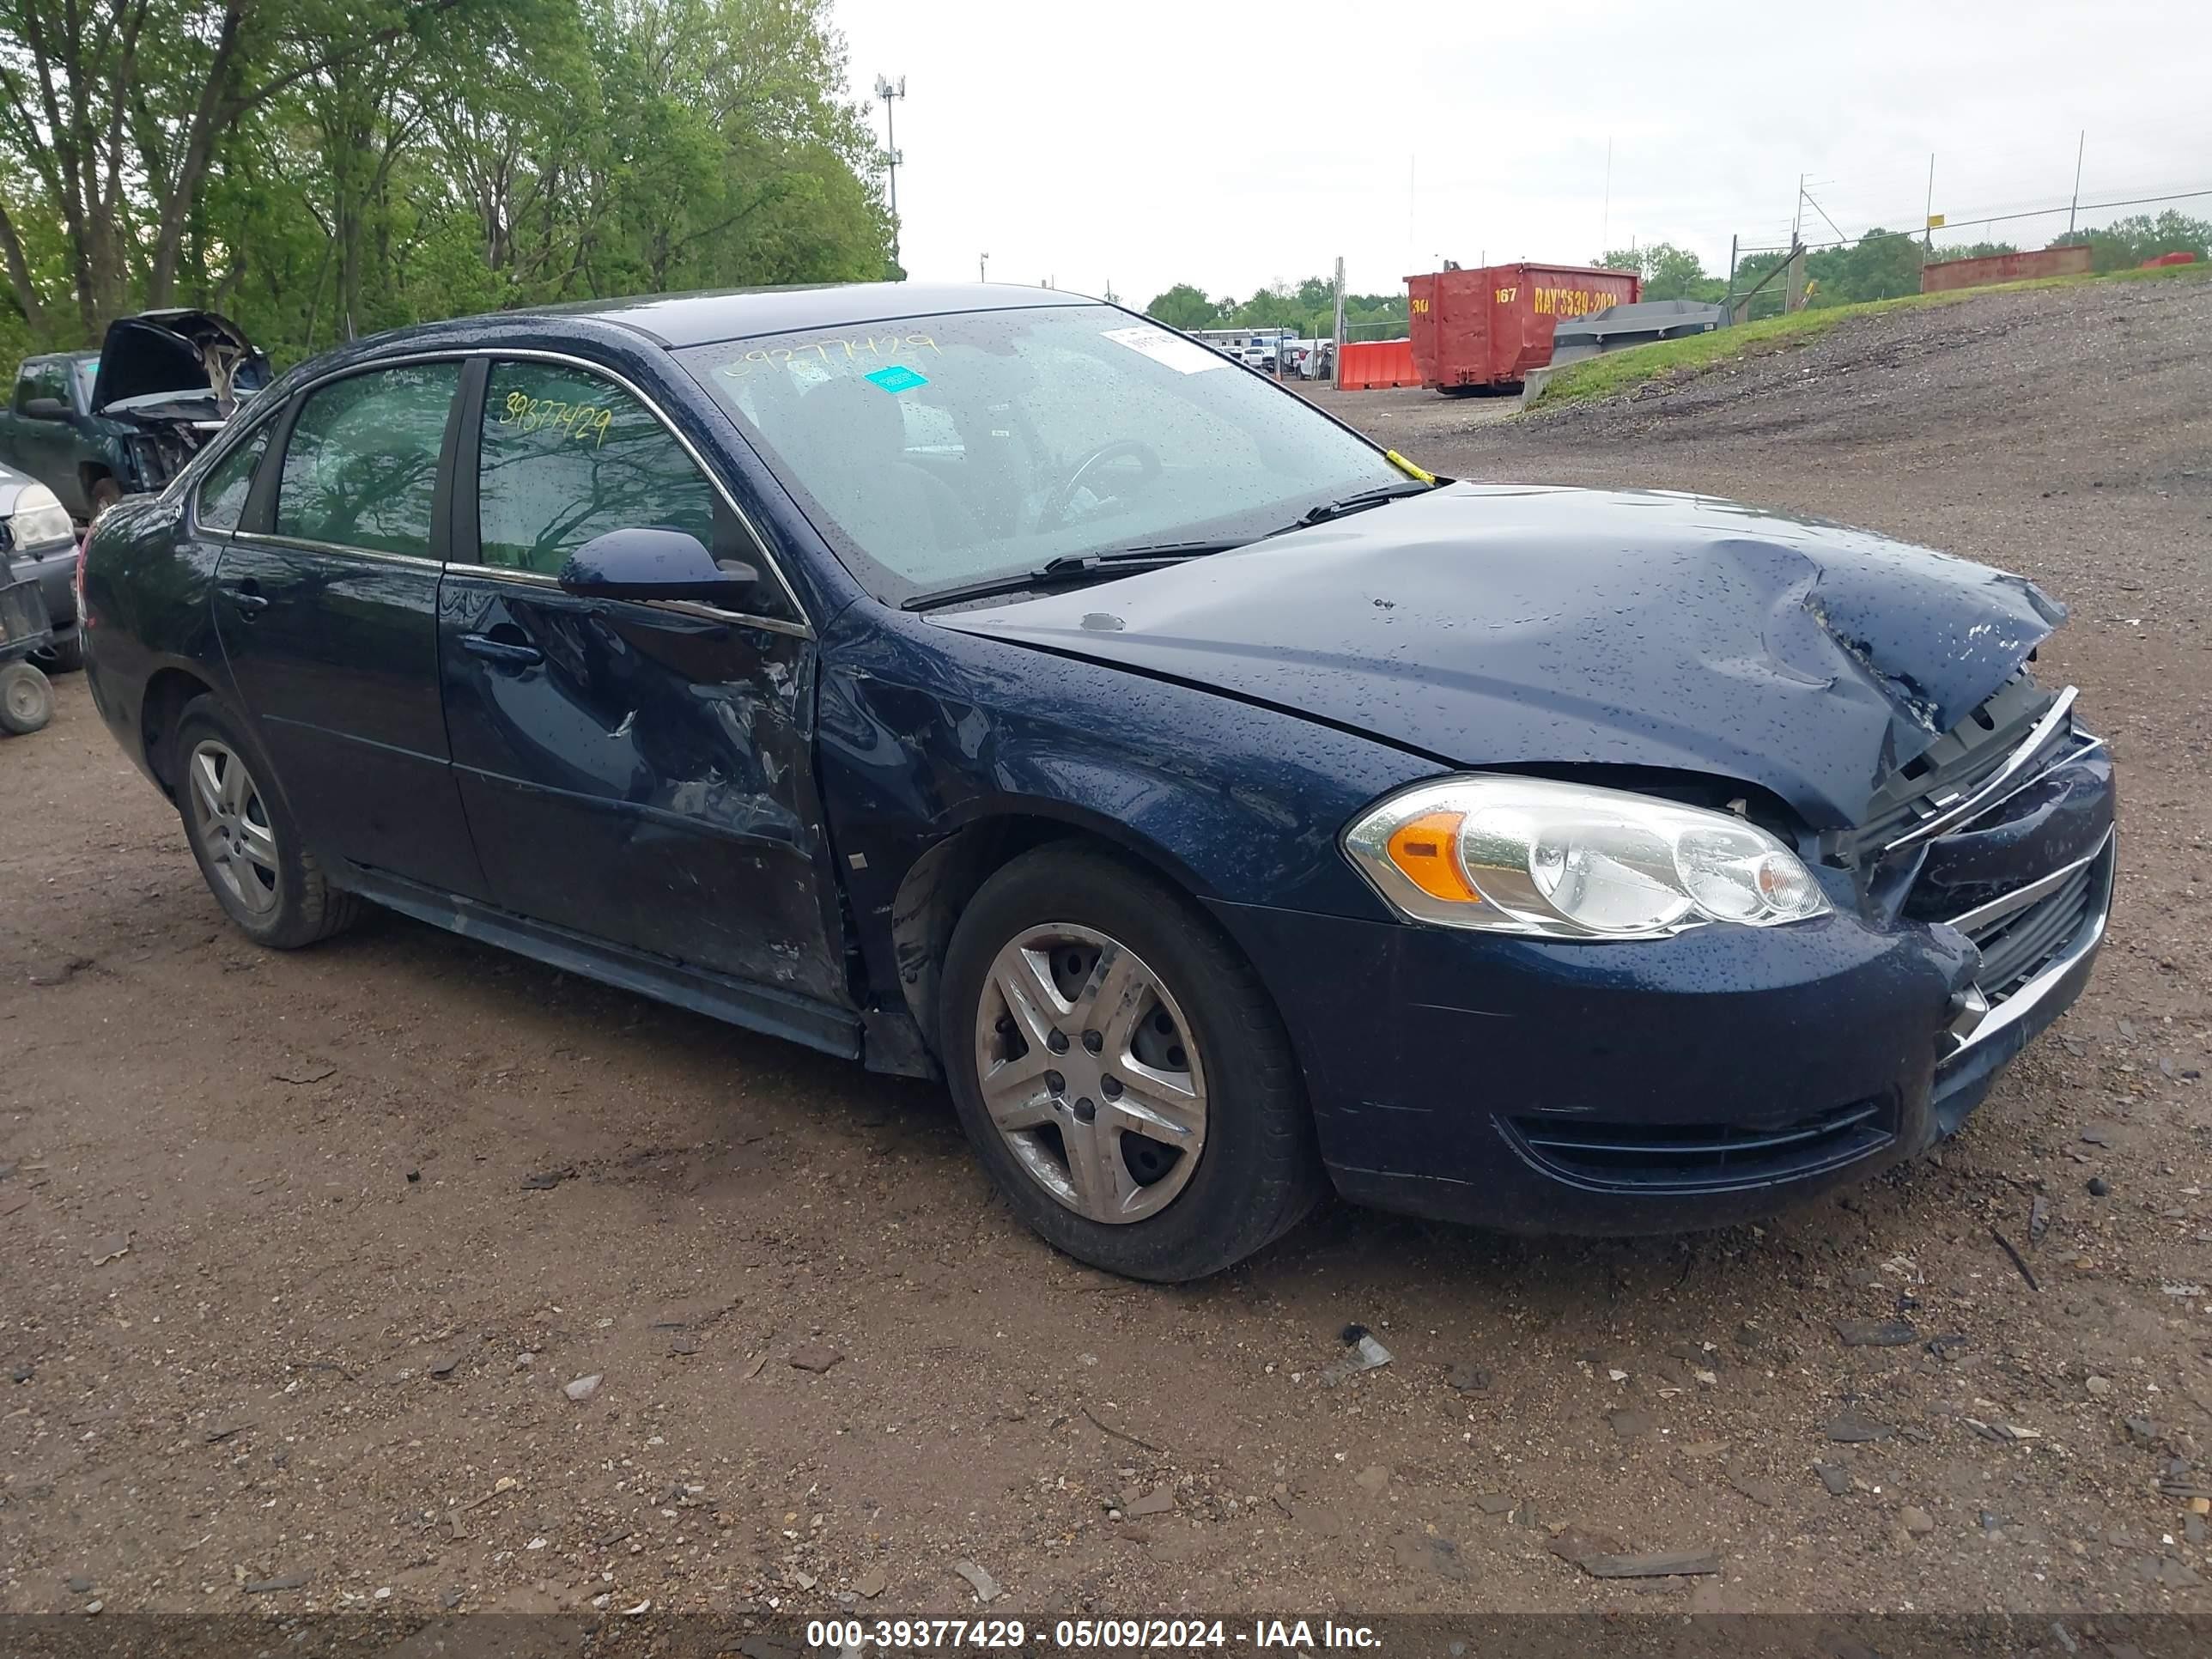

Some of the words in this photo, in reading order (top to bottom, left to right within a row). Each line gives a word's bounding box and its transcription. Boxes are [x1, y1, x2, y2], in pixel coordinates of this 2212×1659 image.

[1495, 288, 1518, 304] 167
[1534, 287, 1567, 314] RAY'S
[499, 391, 612, 450] 39377429
